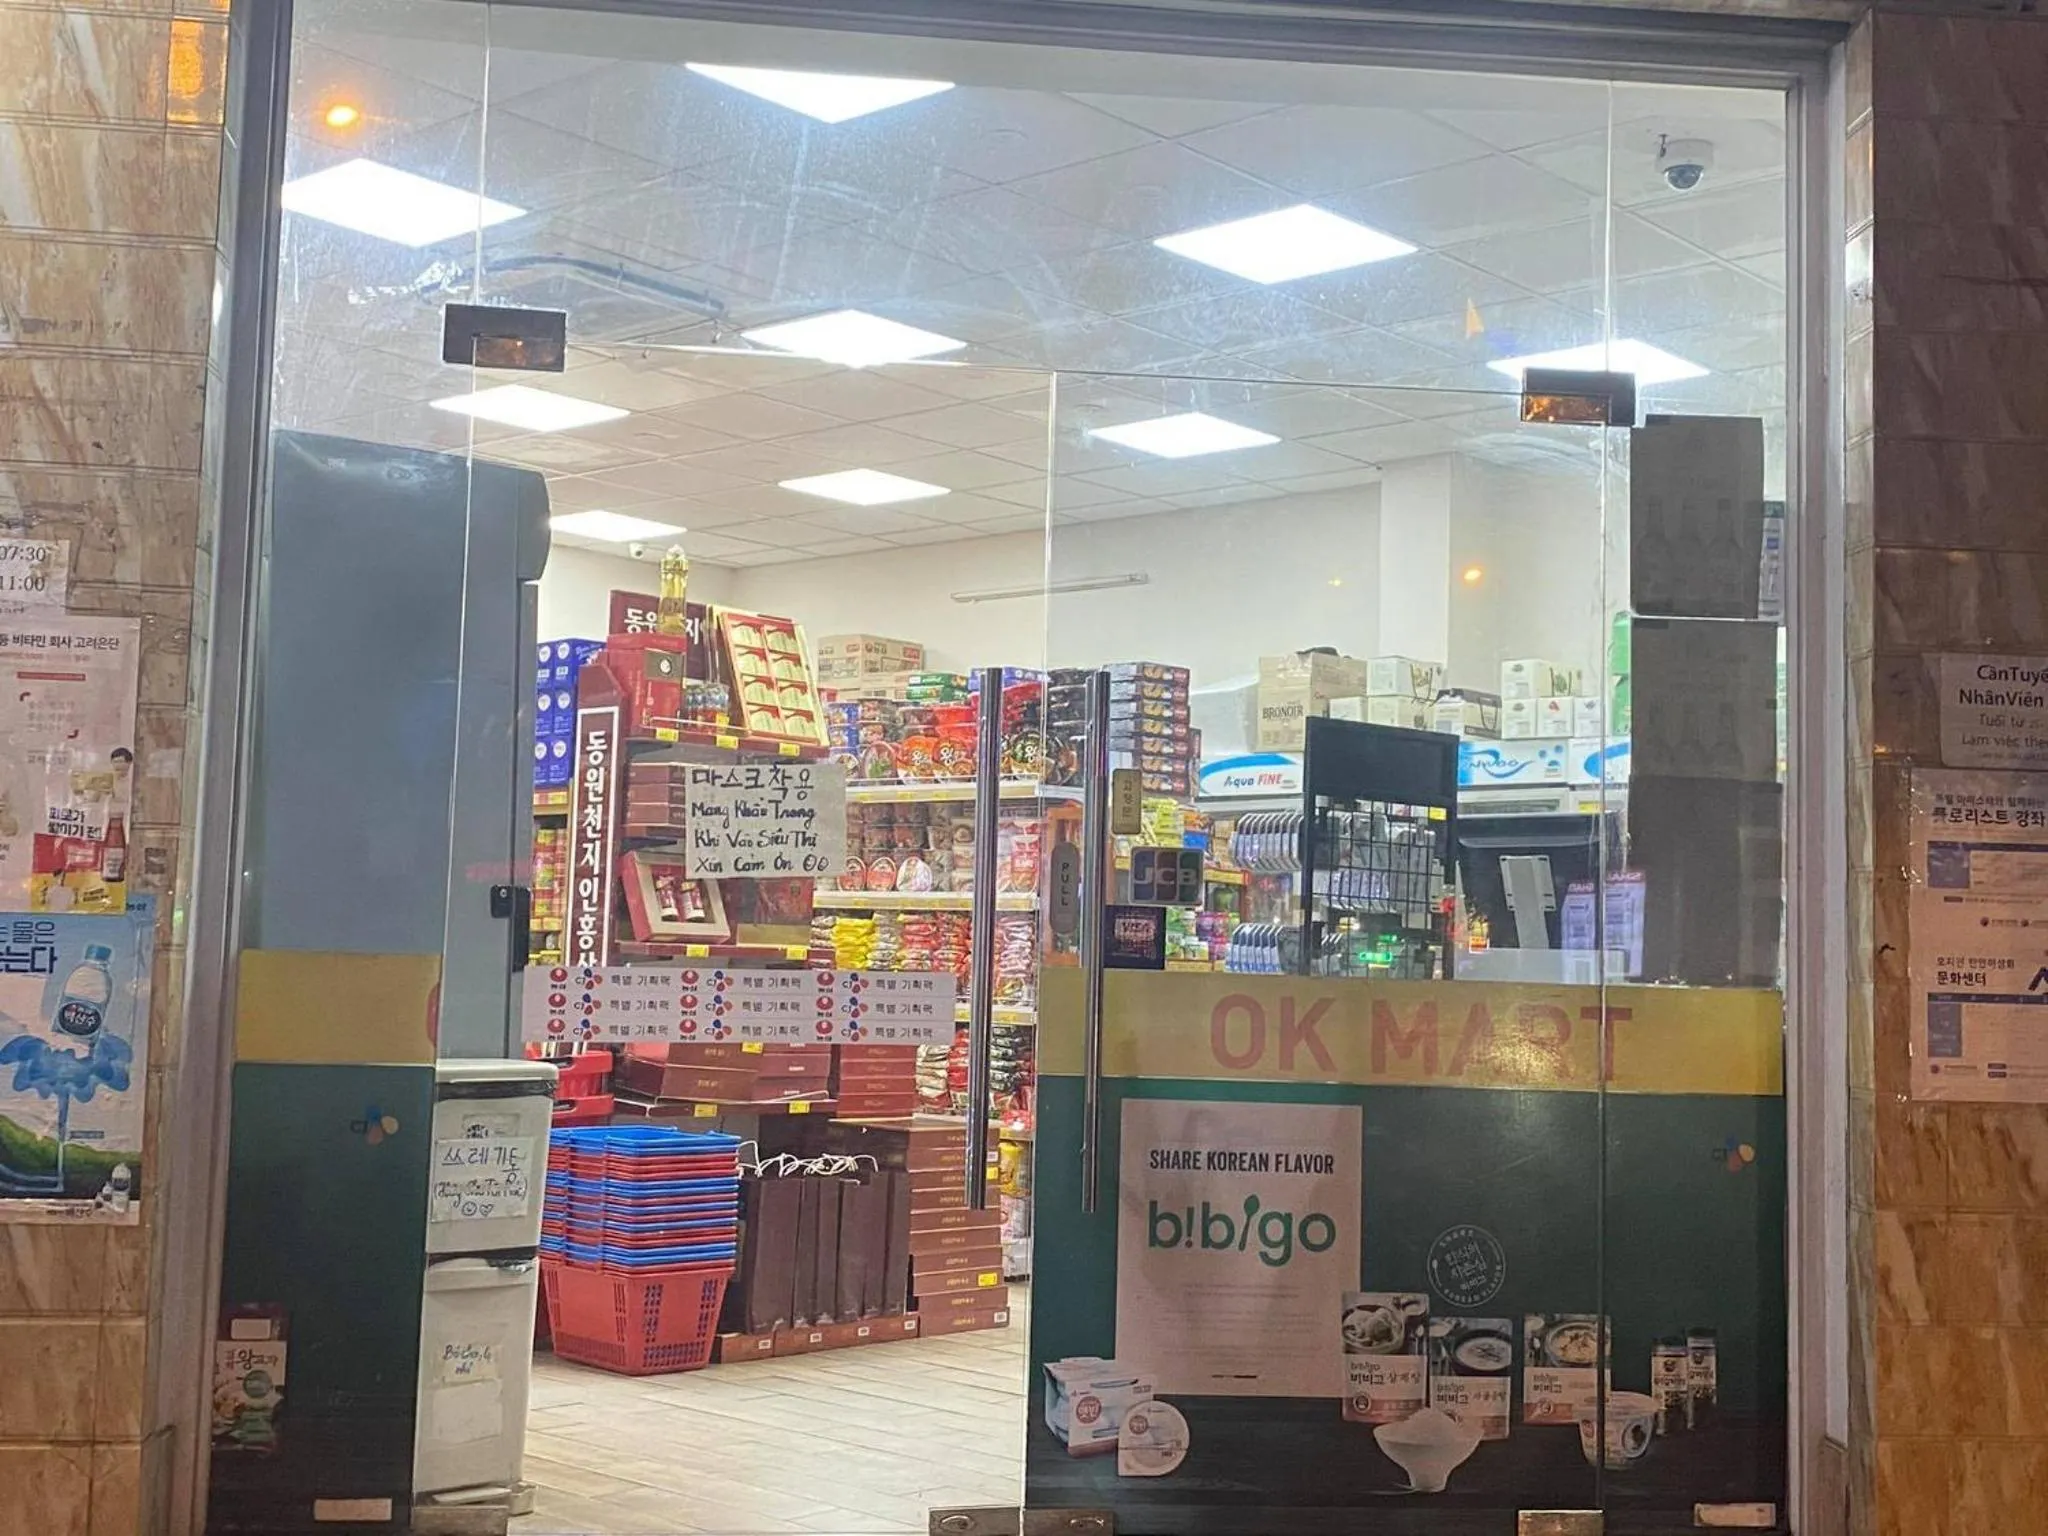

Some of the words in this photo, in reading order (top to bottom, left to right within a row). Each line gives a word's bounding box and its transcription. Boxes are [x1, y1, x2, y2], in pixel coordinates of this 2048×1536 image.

[0, 546, 46, 562] 07:30
[0, 576, 45, 592] 11:00
[12, 634, 46, 648] 비타민
[49, 635, 71, 648] 회사
[74, 637, 120, 650] 고려은단
[1960, 688, 2043, 707] NhânViên
[1224, 776, 1254, 788] Aqua
[692, 802, 729, 829] Mang
[2016, 810, 2045, 827] 강좌
[694, 829, 720, 848] Khi
[695, 857, 722, 873] Xin
[1937, 971, 1986, 987] 문화센터
[1210, 993, 1338, 1073] OK
[1372, 1000, 1632, 1082] MART
[1150, 1149, 1201, 1170] SHARE
[1207, 1151, 1268, 1172] KOREAN
[1275, 1153, 1333, 1174] FLAVOR
[1350, 1373, 1385, 1385] 비비고
[1437, 1393, 1468, 1404] 비비고
